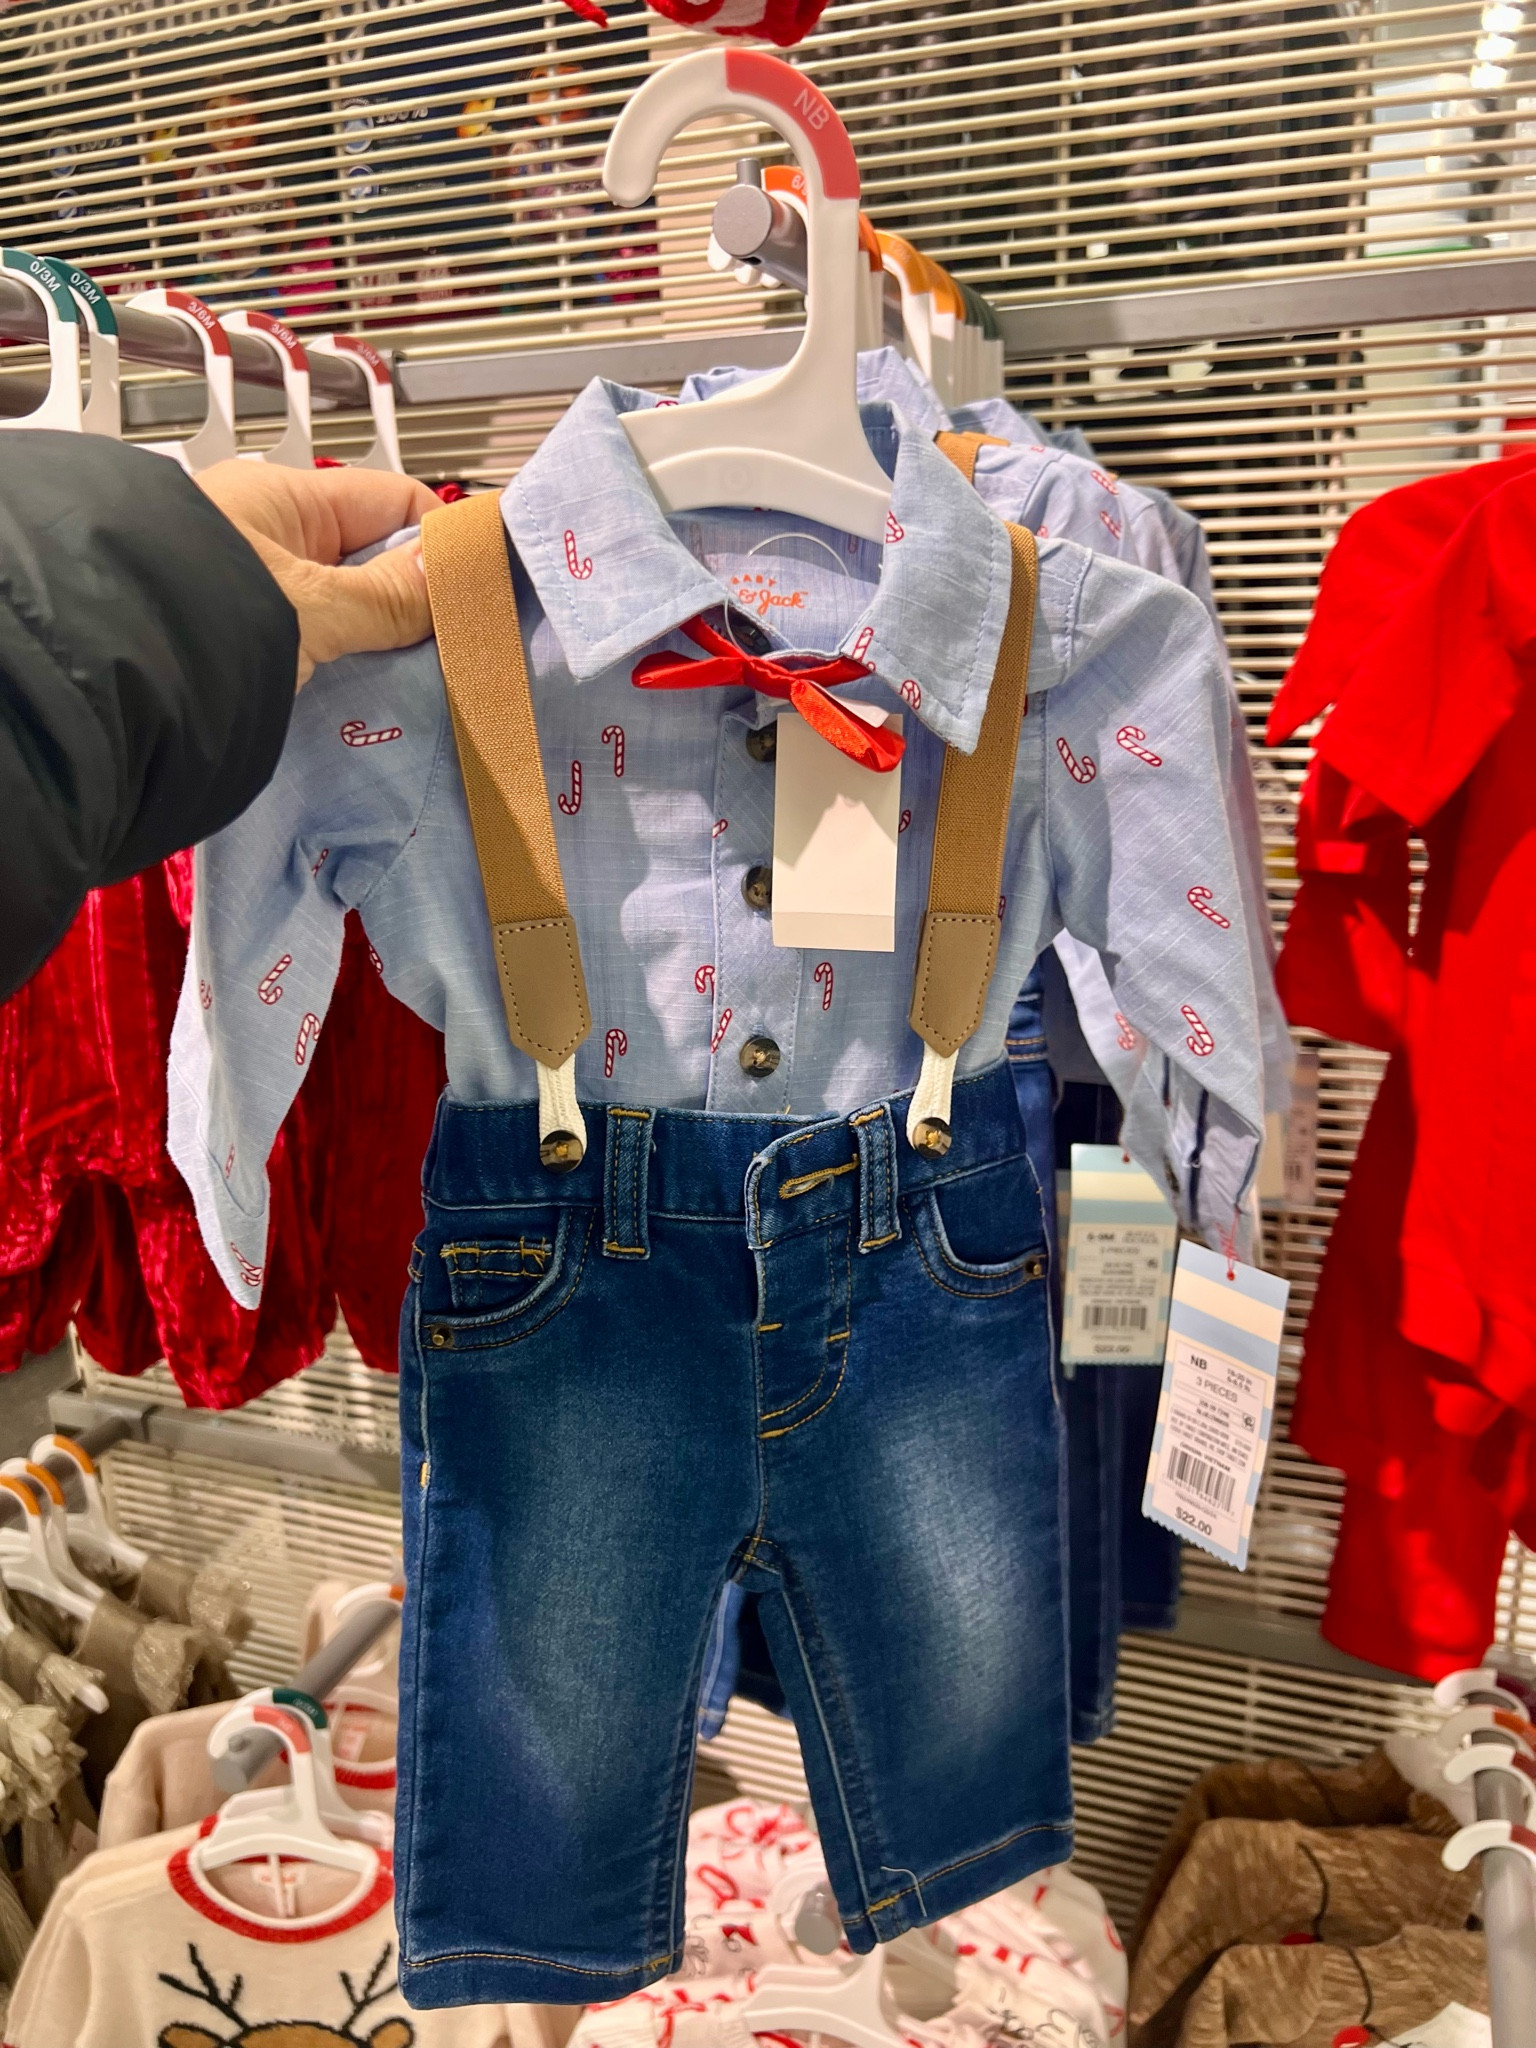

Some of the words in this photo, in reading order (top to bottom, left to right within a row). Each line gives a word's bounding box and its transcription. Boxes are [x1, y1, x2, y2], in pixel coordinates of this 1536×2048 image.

[793, 87, 830, 130] NB
[29, 260, 61, 292] 0/3M
[70, 272, 101, 304] 0/3M
[187, 301, 215, 329] 3/6M
[268, 322, 297, 349] 3/6M
[730, 573, 776, 588] BABY
[1190, 1354, 1208, 1370] NB
[1195, 1376, 1203, 1386] 3
[1204, 1379, 1238, 1403] PIECES
[1174, 1506, 1213, 1536] $22.00
